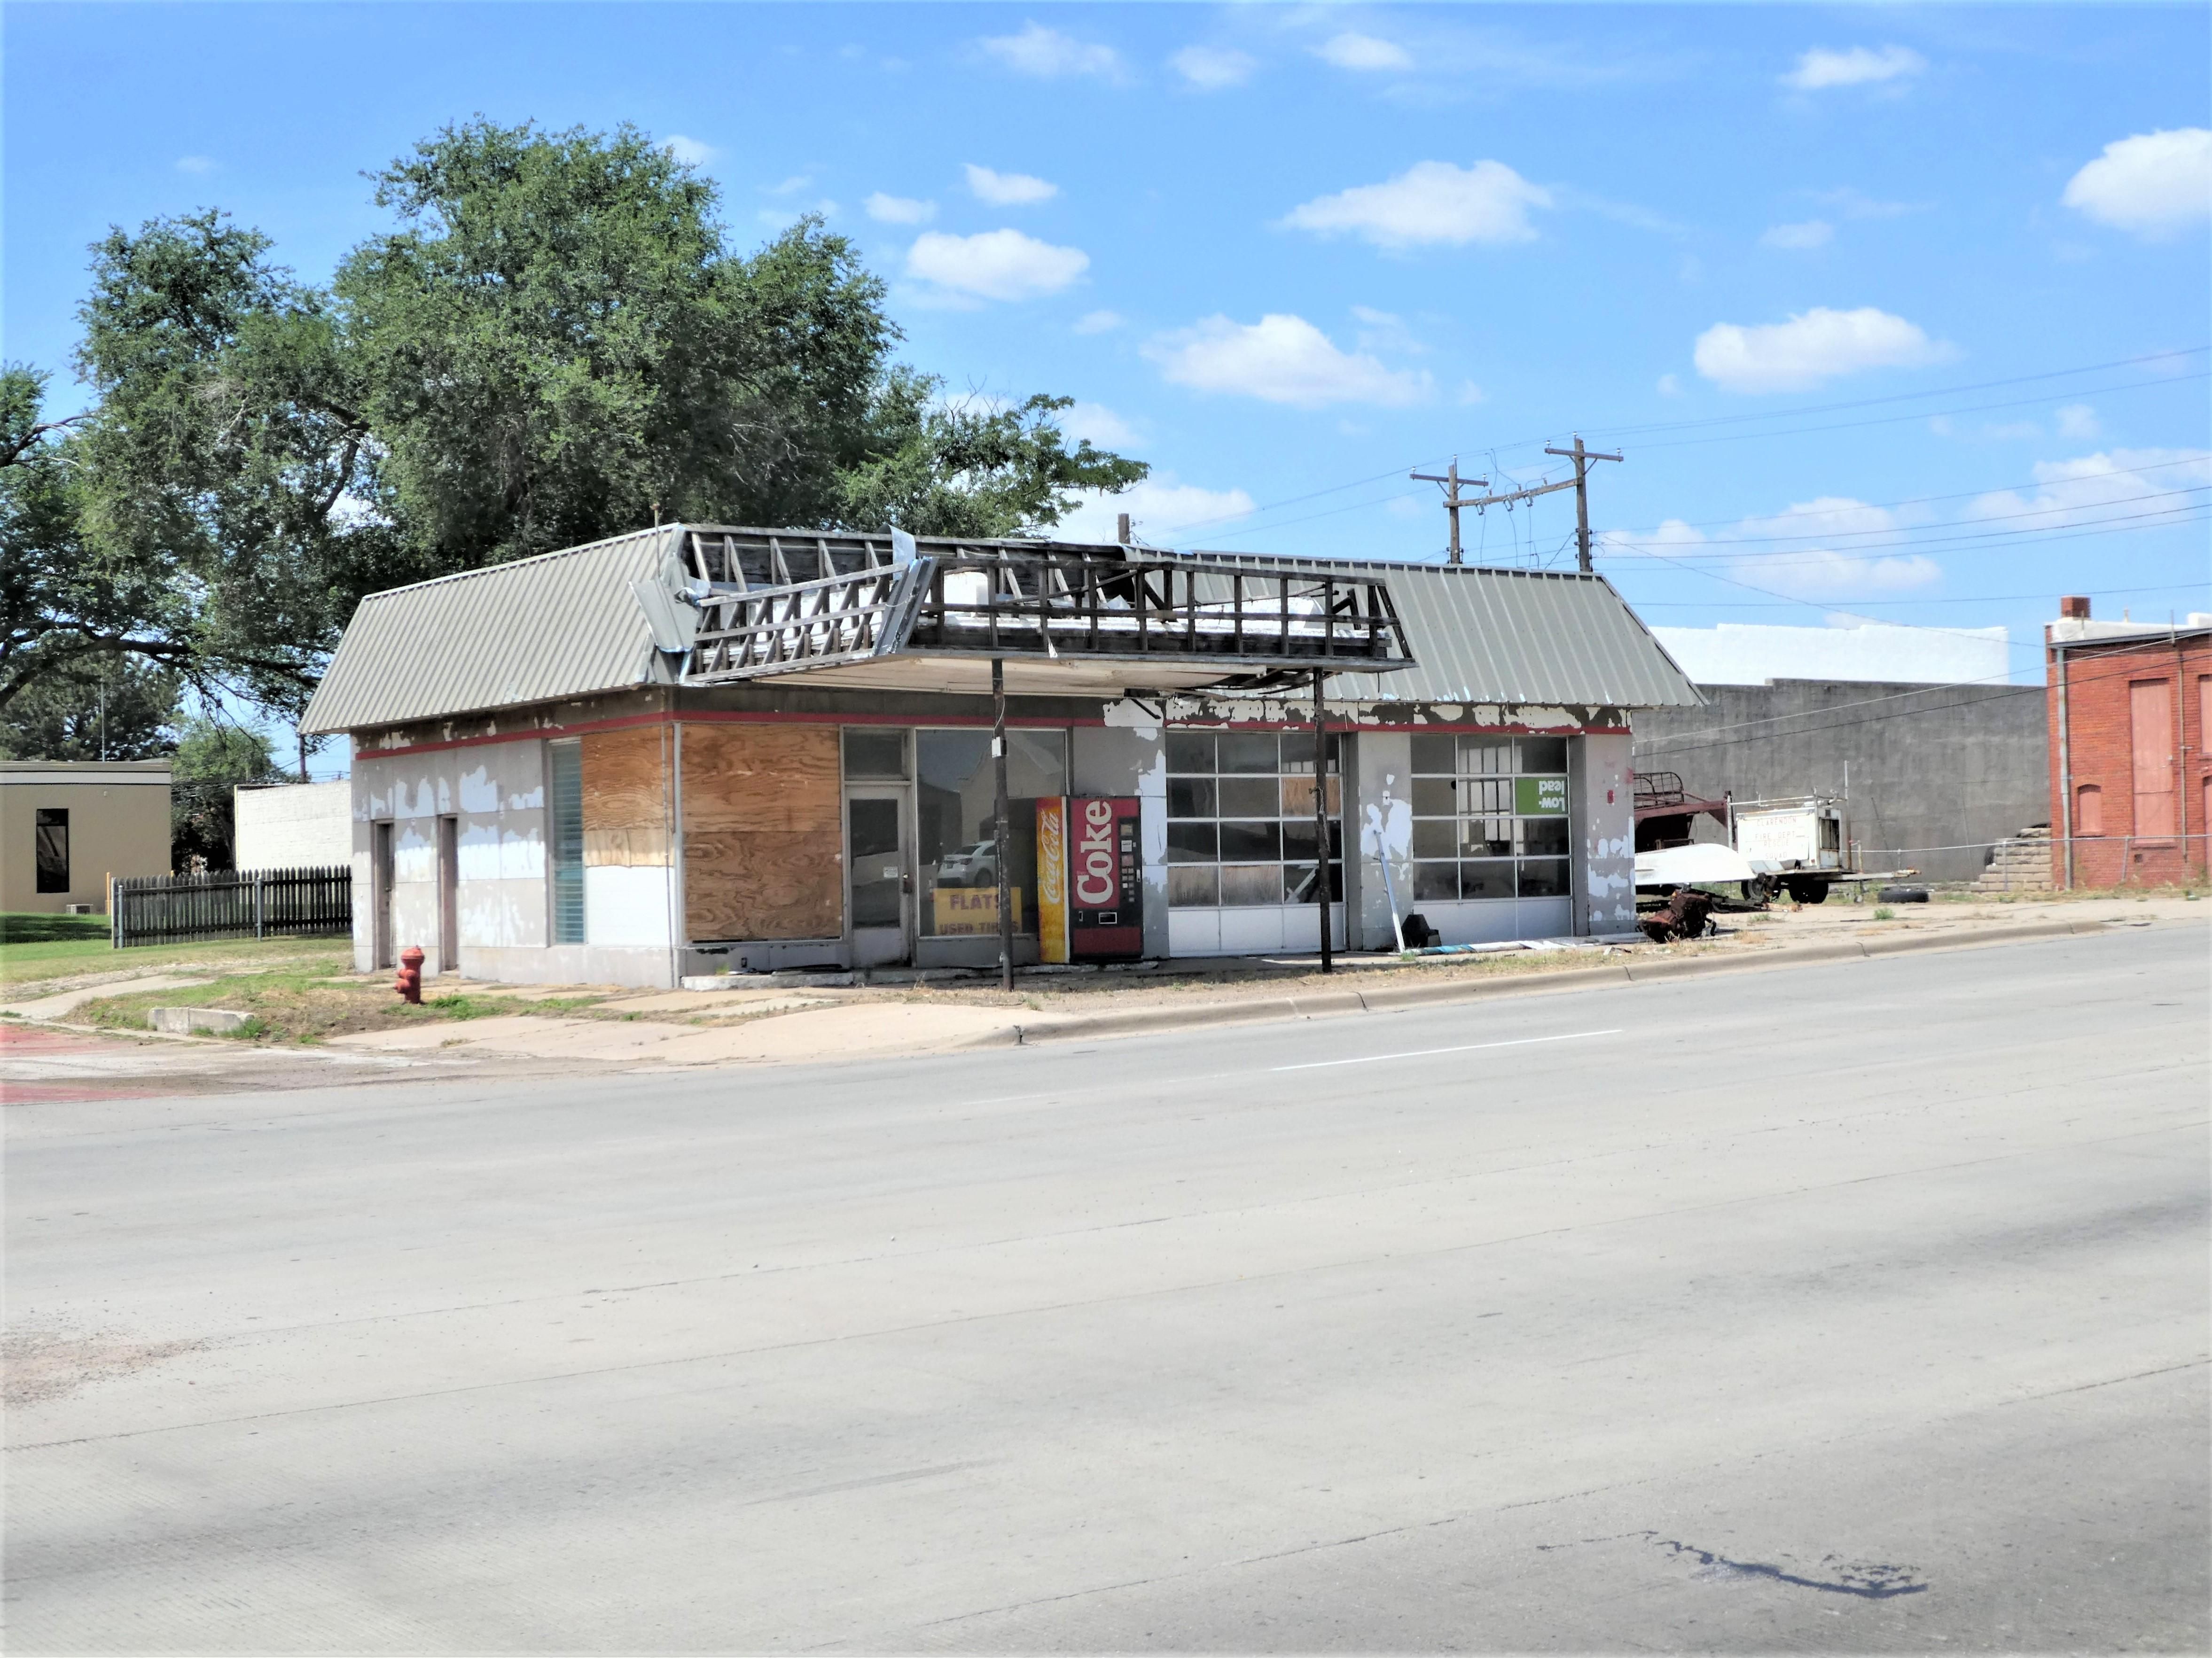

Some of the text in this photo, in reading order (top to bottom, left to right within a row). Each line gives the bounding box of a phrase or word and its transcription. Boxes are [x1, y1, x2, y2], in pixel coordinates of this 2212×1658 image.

[1539, 781, 1564, 795] lead
[1539, 797, 1565, 811] Low-
[1757, 817, 1797, 826] CLARENDON
[1764, 839, 1790, 848] RESCUE
[1077, 801, 1113, 904] Coke
[940, 921, 1019, 934] USED TIRS
